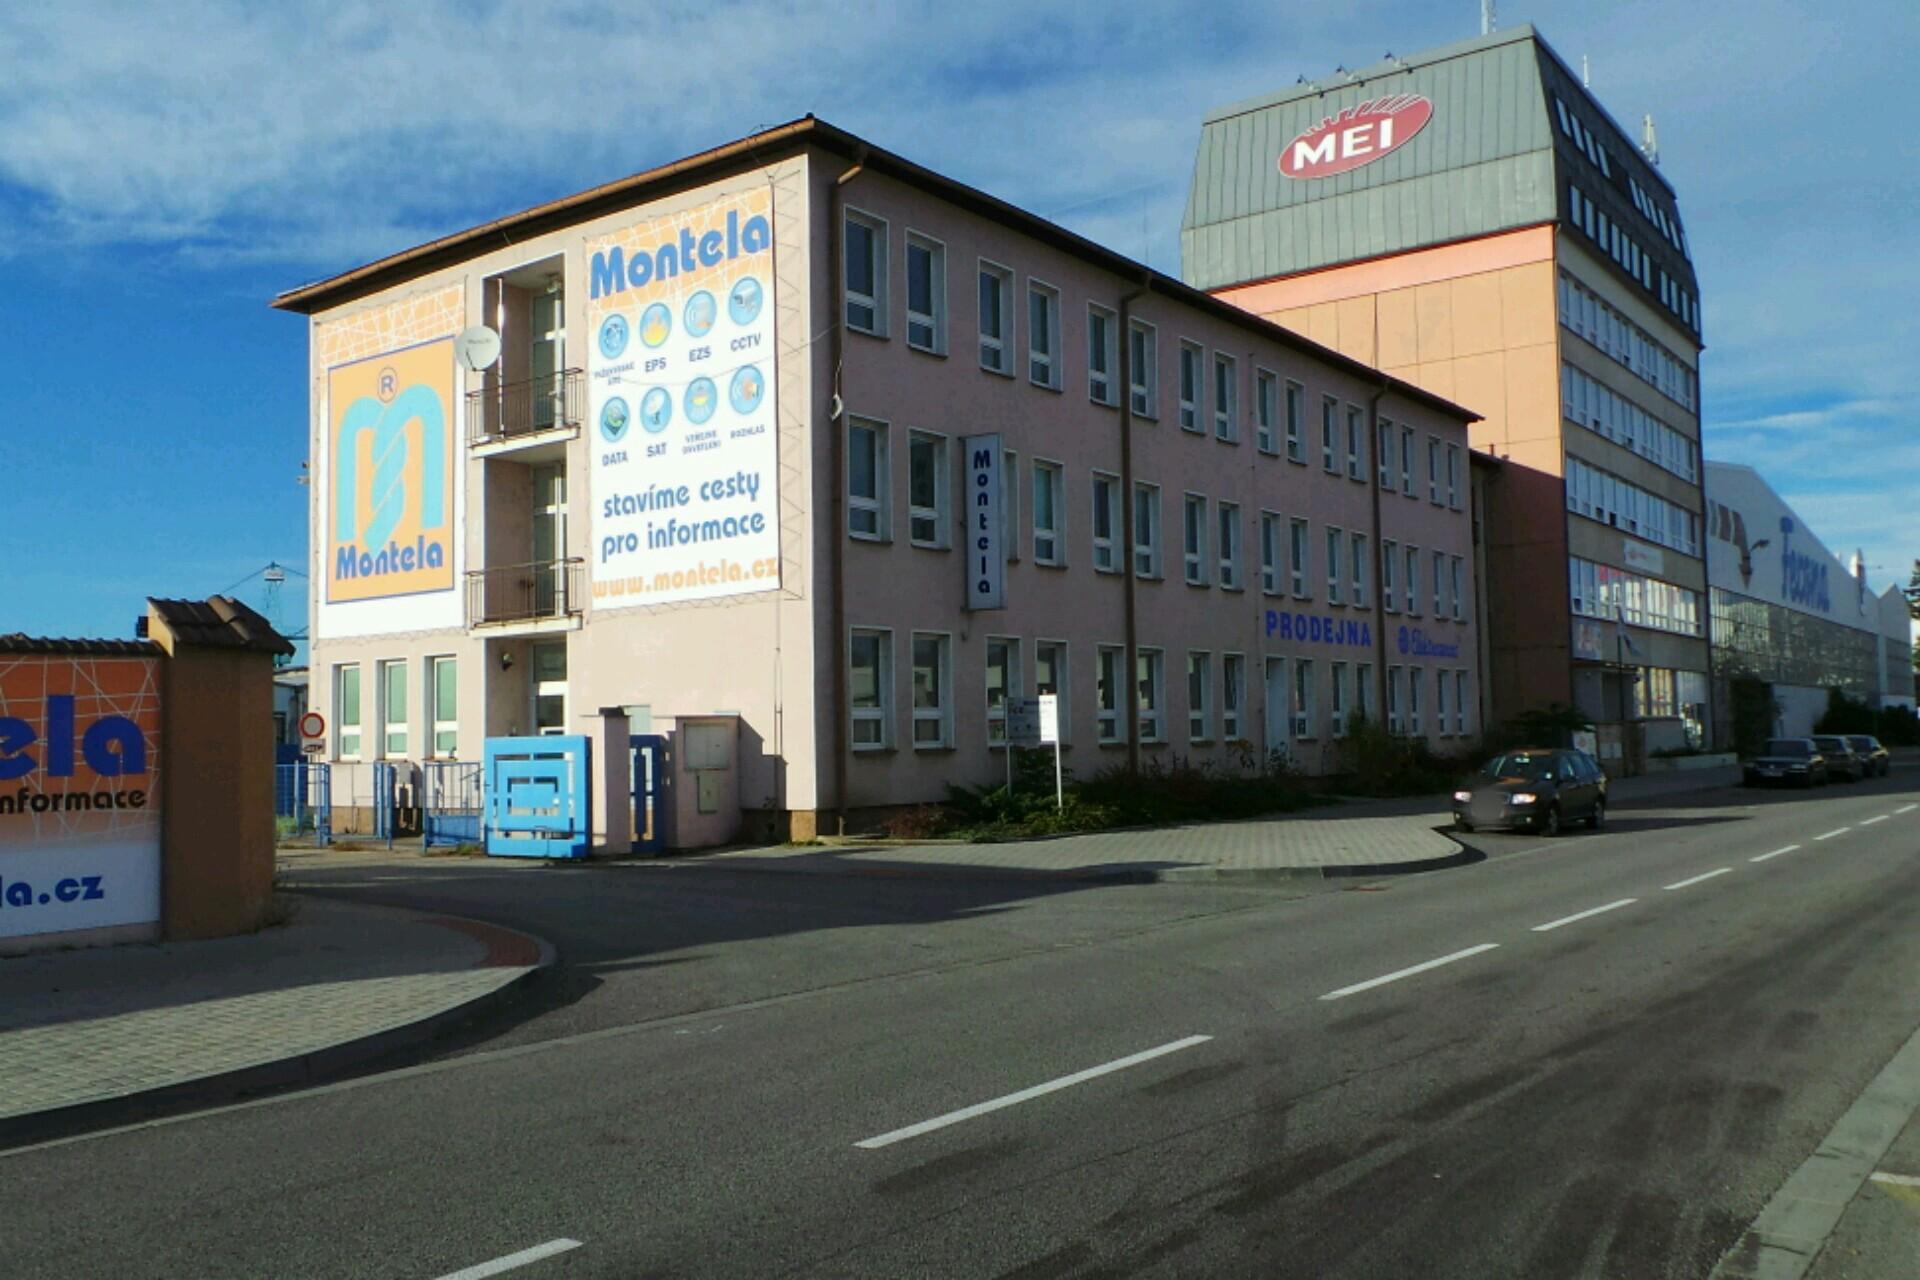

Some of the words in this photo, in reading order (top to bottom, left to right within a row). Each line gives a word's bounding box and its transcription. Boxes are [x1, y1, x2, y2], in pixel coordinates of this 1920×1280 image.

[1293, 118, 1393, 170] MEI
[590, 209, 770, 300] Montela
[689, 346, 712, 362] EZS
[730, 333, 762, 352] CCTV
[645, 357, 667, 372] EPS
[602, 451, 628, 467] DATA
[647, 442, 667, 457] SAT
[604, 484, 690, 518] stavíme
[700, 471, 760, 501] cesty
[602, 533, 638, 564] pro
[648, 513, 765, 549] informace
[972, 450, 991, 594] Montela
[336, 535, 443, 580] Montela
[592, 557, 778, 598] www.montela.cz
[1265, 610, 1371, 647] PRODEJNA
